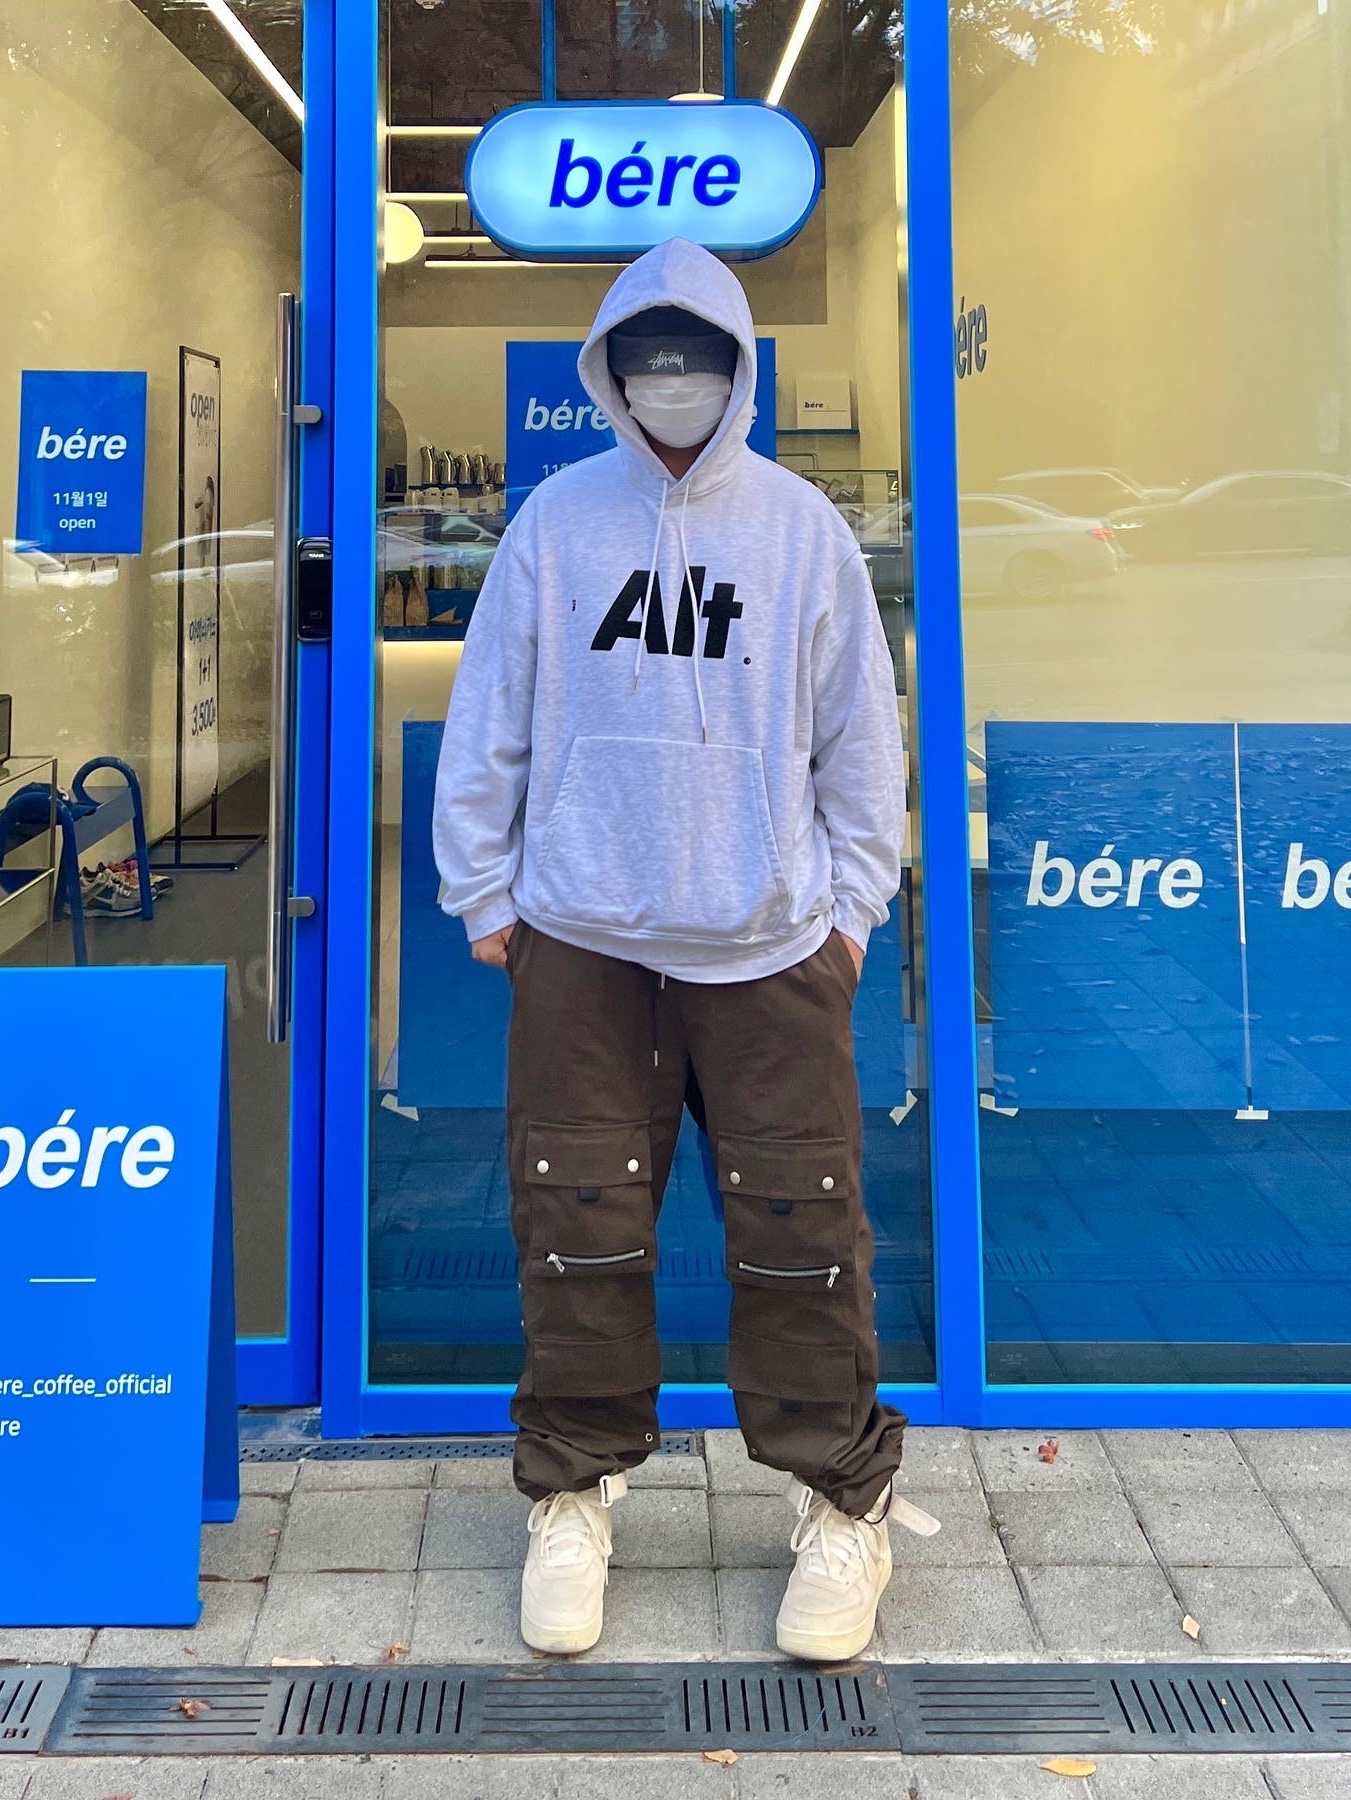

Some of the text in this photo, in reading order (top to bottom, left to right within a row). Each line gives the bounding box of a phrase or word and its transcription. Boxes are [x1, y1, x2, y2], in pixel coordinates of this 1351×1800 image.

[549, 138, 742, 208] bére
[954, 295, 988, 380] ére
[190, 392, 216, 428] open
[37, 426, 128, 460] bére
[53, 491, 108, 507] 11월1일
[58, 517, 96, 532] open
[1026, 840, 1204, 909] bére
